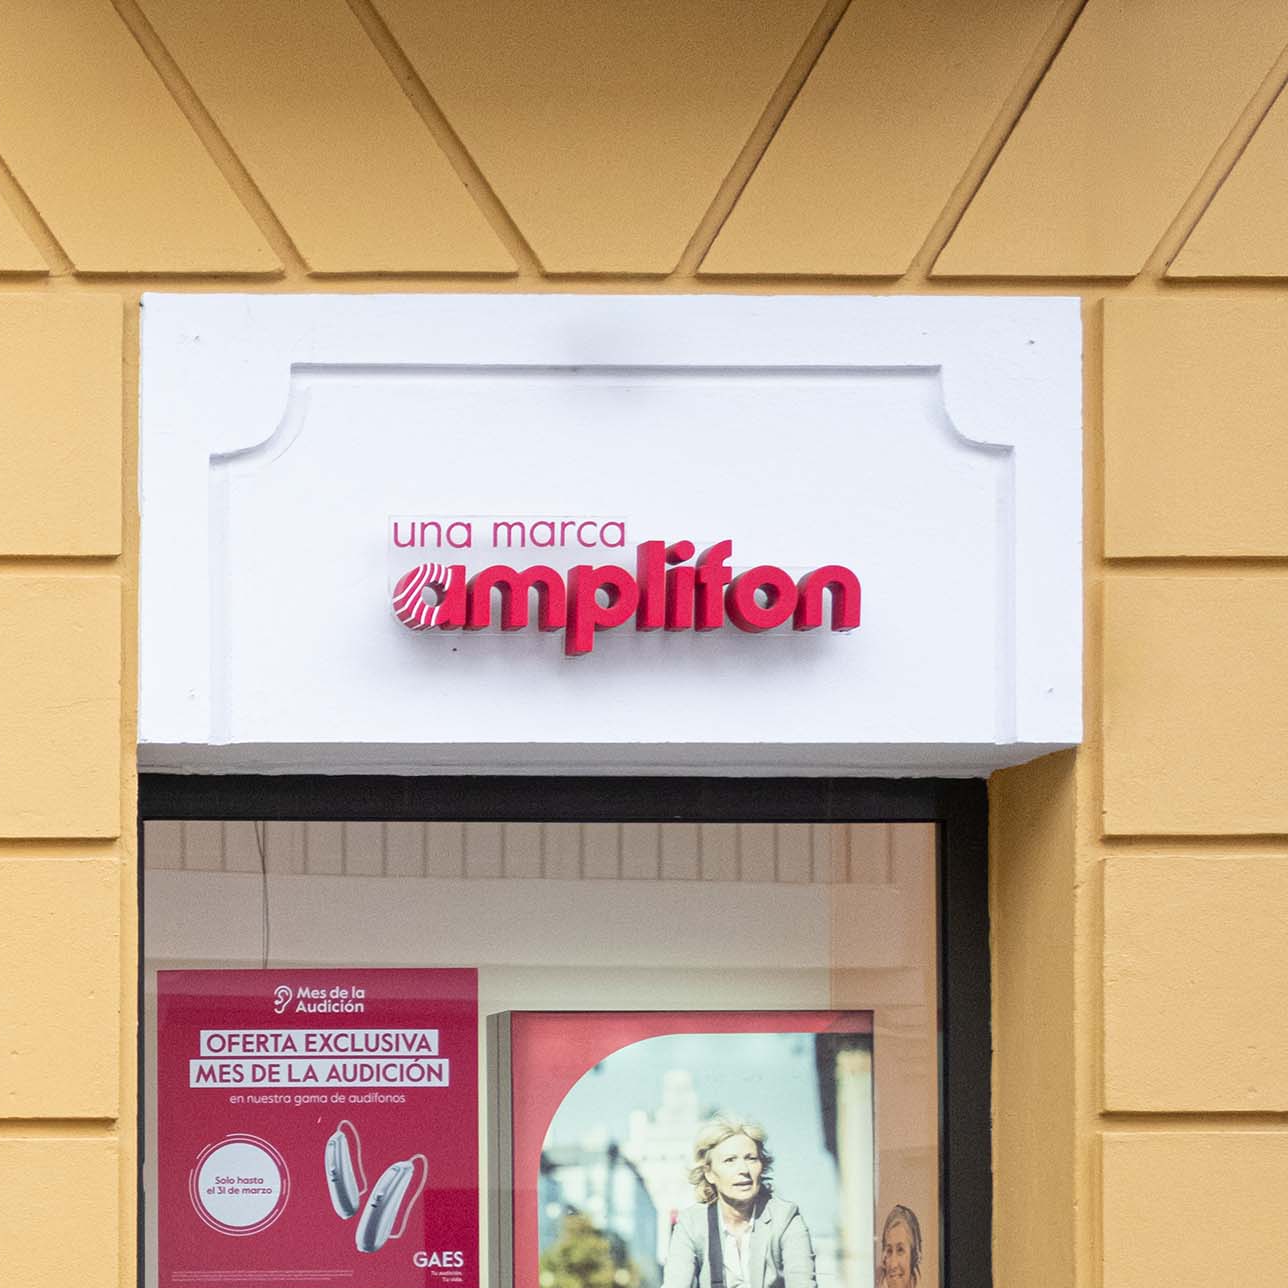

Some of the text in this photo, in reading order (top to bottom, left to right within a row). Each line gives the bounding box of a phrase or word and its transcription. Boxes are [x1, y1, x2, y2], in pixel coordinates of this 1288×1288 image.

[393, 520, 625, 549] una marca
[393, 540, 861, 656] amplifon
[296, 987, 365, 999] Mes de la
[296, 999, 364, 1013] Audición
[206, 1033, 432, 1053] OFERTA EXCLUSIVA
[196, 1058, 443, 1083] MES DE LA AUDICIÓN
[229, 1092, 406, 1106] en nuestra gama de audífonos
[215, 1176, 264, 1185] Solo hasta
[206, 1186, 215, 1195] el
[227, 1186, 238, 1195] de
[413, 1251, 464, 1268] GAES
